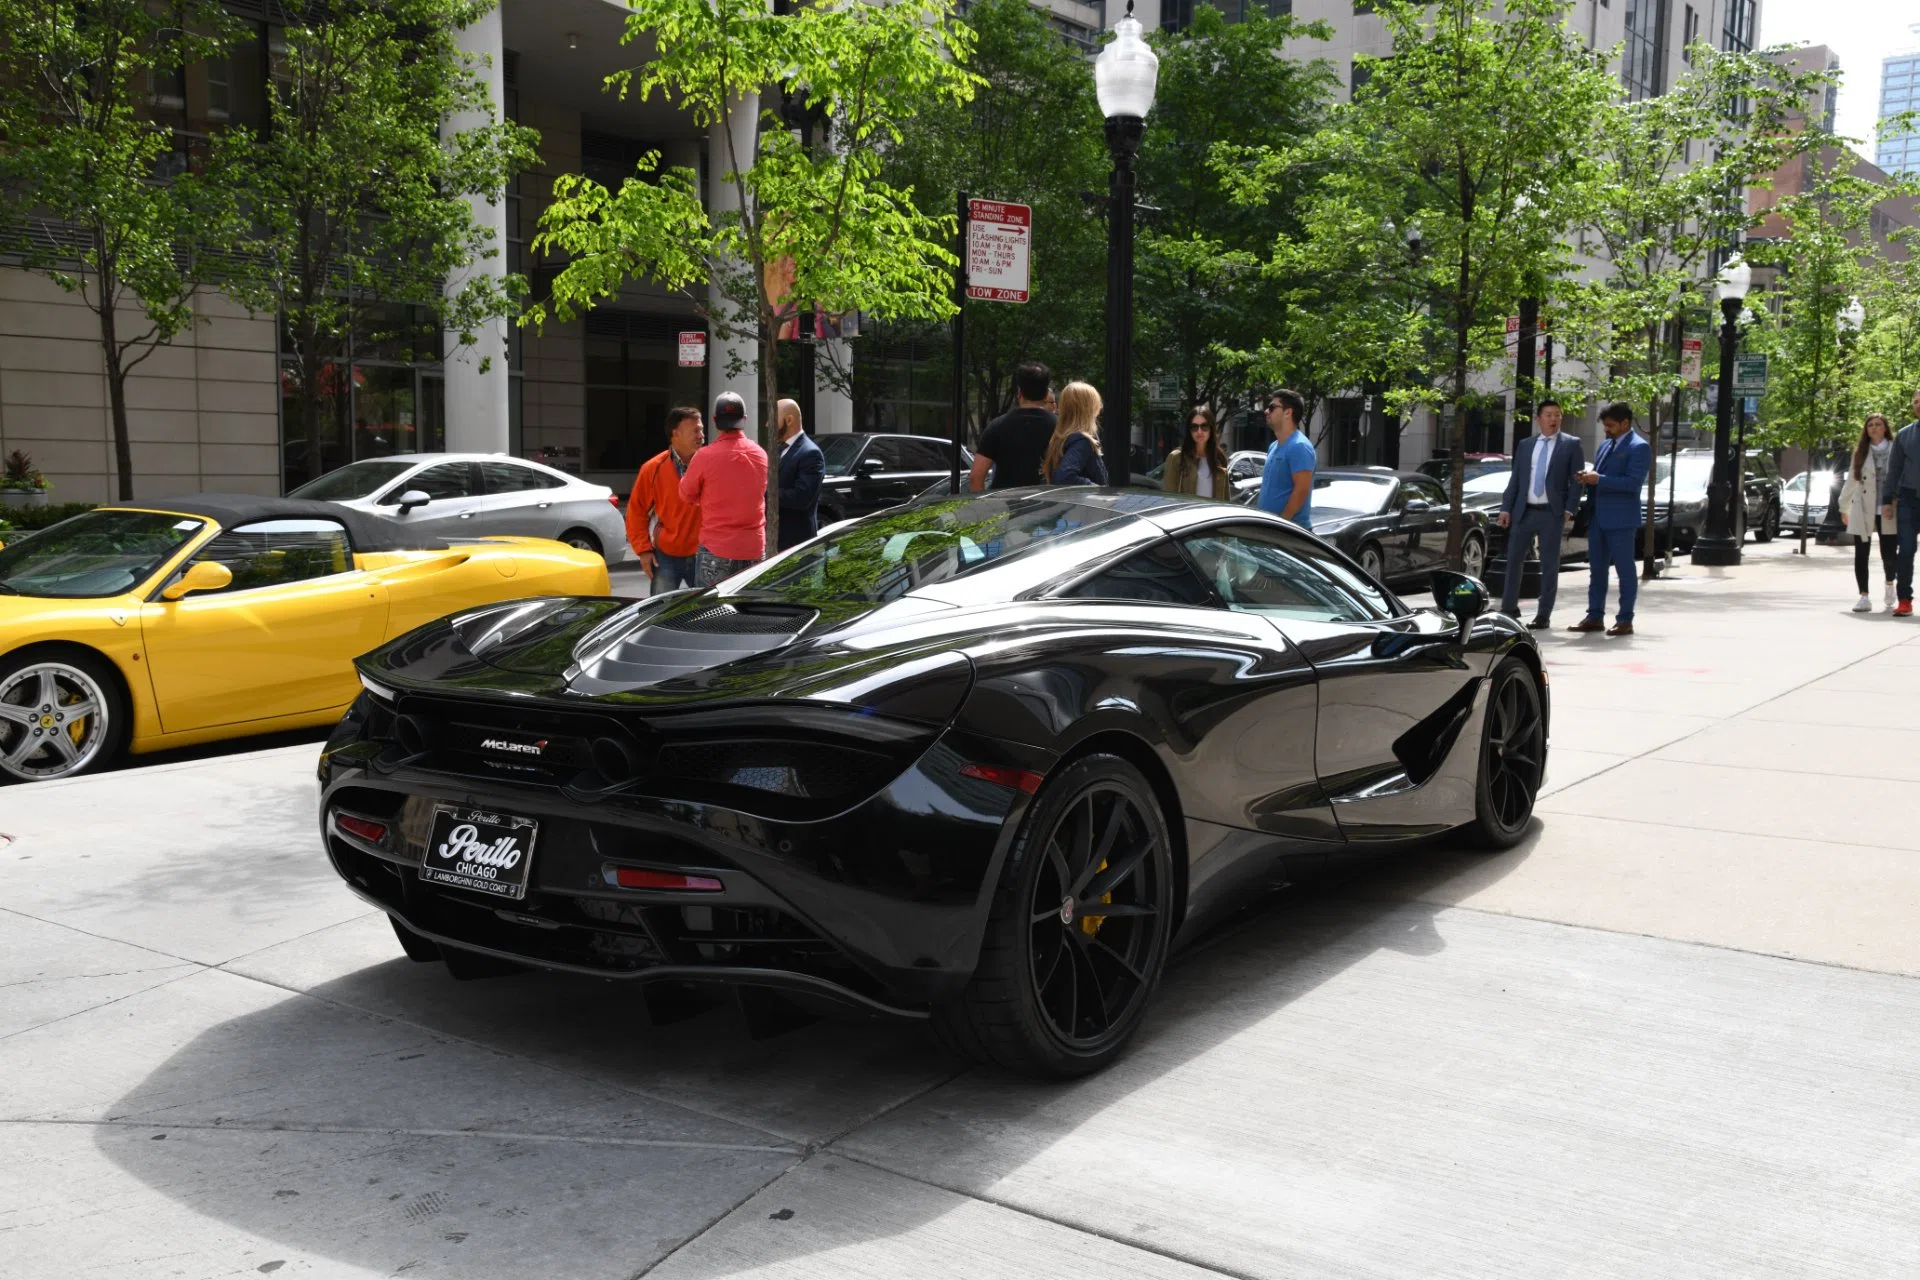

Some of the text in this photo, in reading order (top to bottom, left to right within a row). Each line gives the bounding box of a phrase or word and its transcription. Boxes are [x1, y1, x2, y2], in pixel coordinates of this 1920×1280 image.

[973, 202, 1005, 213] 15 MINUTE
[973, 211, 1024, 224] STANDING ZONE
[972, 224, 985, 232] USE
[972, 233, 1026, 245] FLASHING LIGHTS
[993, 251, 1015, 260] THURS
[971, 287, 1024, 300] TOW ZONE
[480, 739, 541, 755] McLaren
[467, 810, 501, 825] Perillo
[438, 824, 521, 870] Perillo
[455, 861, 498, 879] CHICAGO
[433, 871, 508, 894] LAMBORGHINI GOLD COAST
